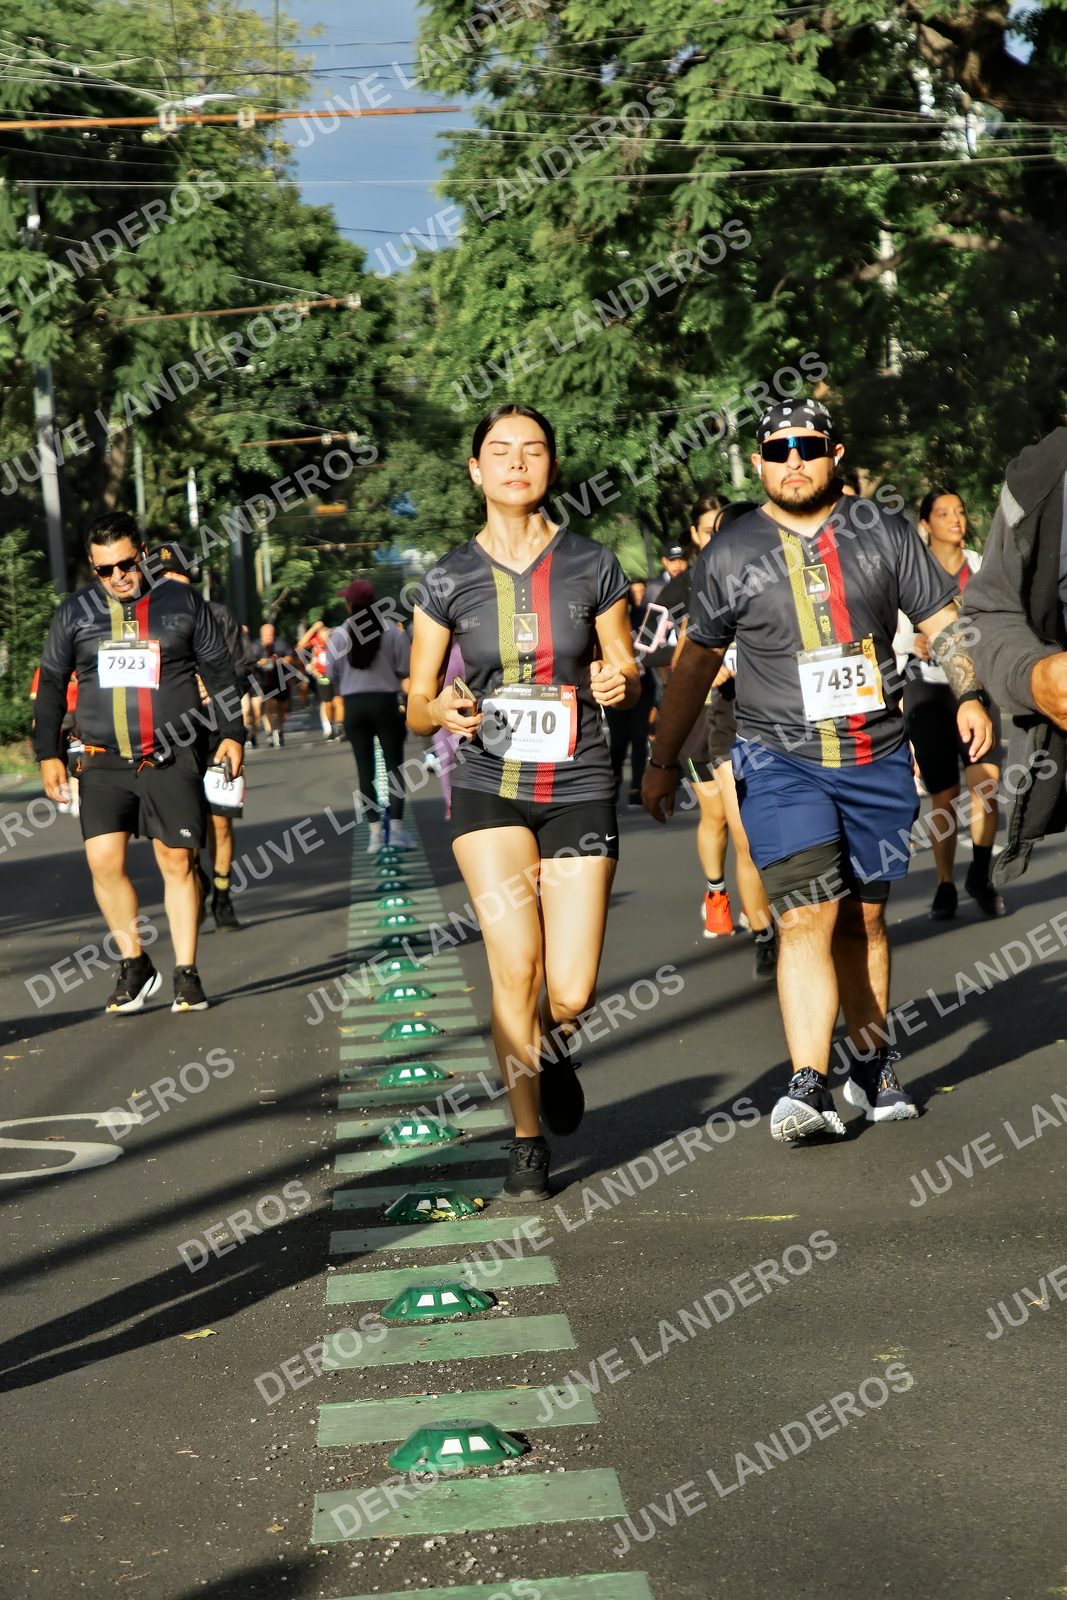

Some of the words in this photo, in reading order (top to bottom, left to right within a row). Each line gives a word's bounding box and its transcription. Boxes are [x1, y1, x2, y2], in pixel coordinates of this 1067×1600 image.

[107, 655, 146, 670] 7923
[812, 664, 866, 693] 7435
[494, 709, 556, 735] 9710
